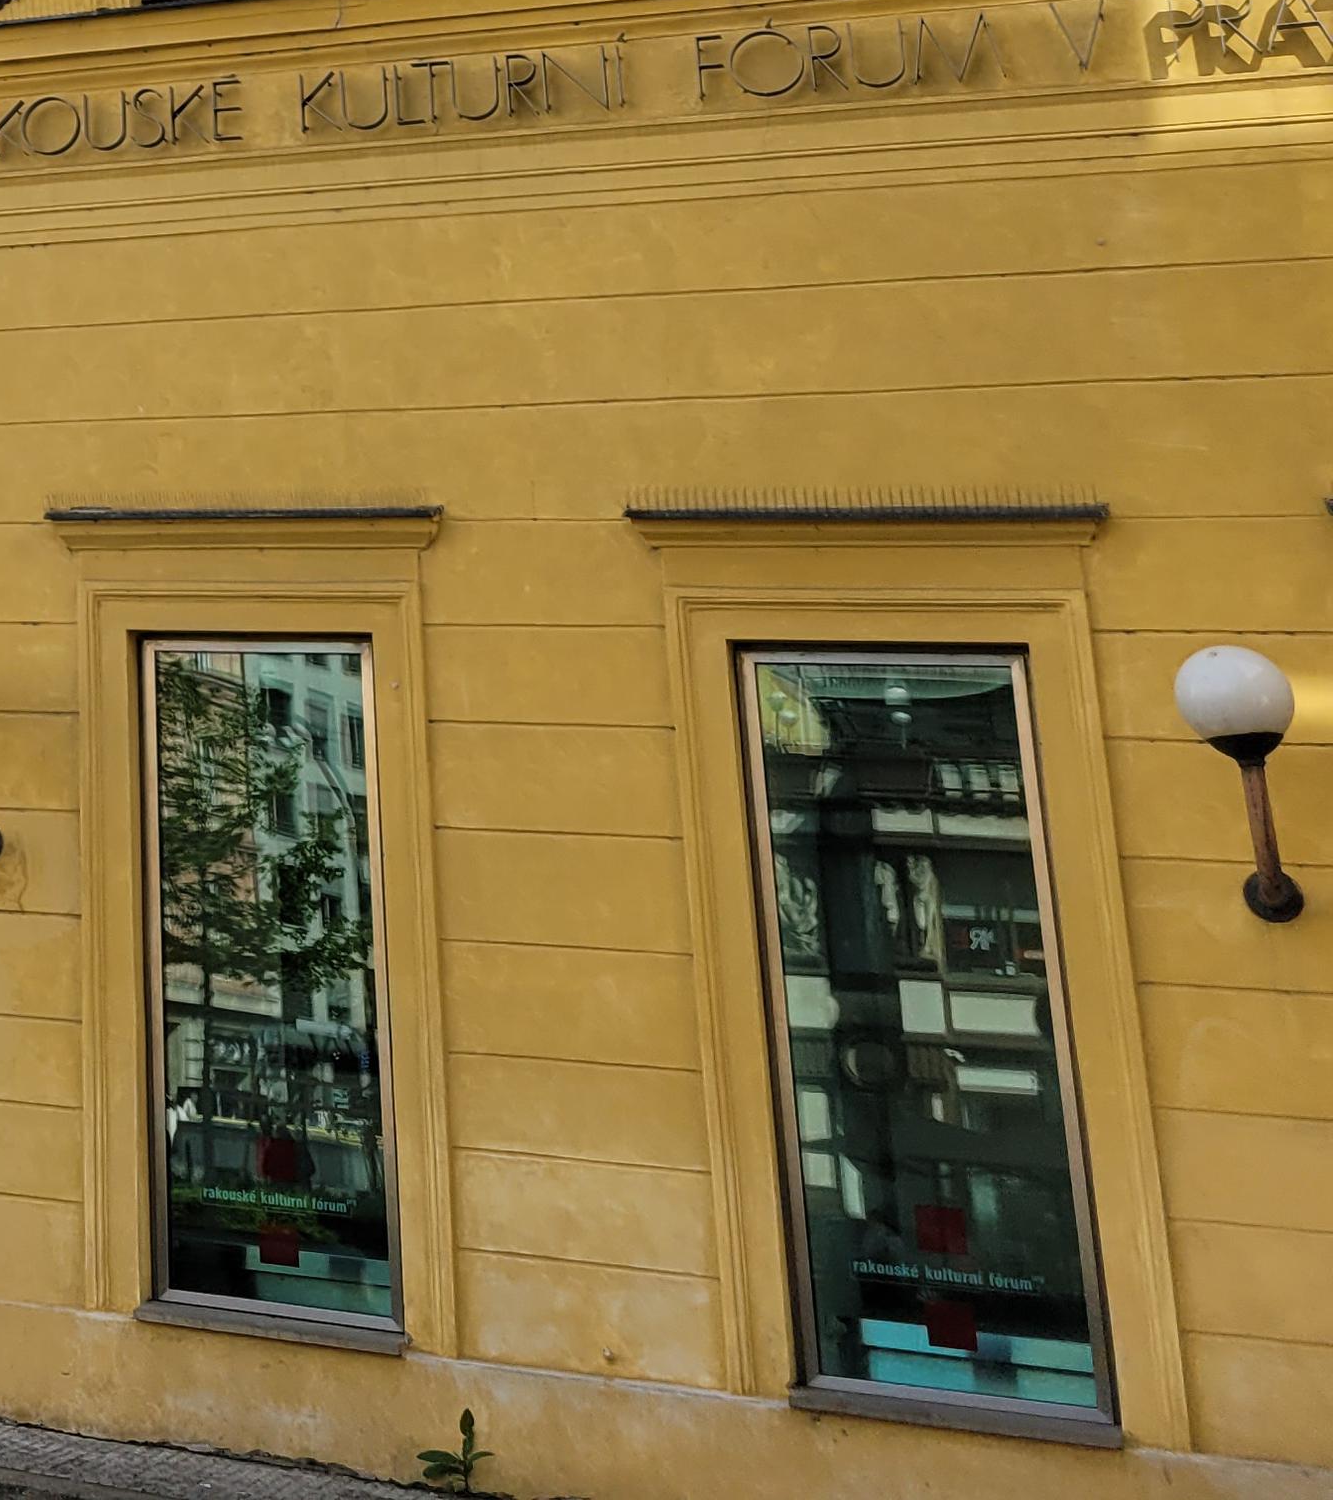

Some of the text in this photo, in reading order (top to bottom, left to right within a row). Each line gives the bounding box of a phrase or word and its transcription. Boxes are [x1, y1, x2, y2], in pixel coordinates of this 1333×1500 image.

[299, 33, 627, 134] KULTURNÍ
[695, 18, 1008, 101] FÓRUM
[203, 1186, 256, 1203] rakouské
[261, 1191, 308, 1208] kulturní
[853, 1259, 919, 1279] rakouské
